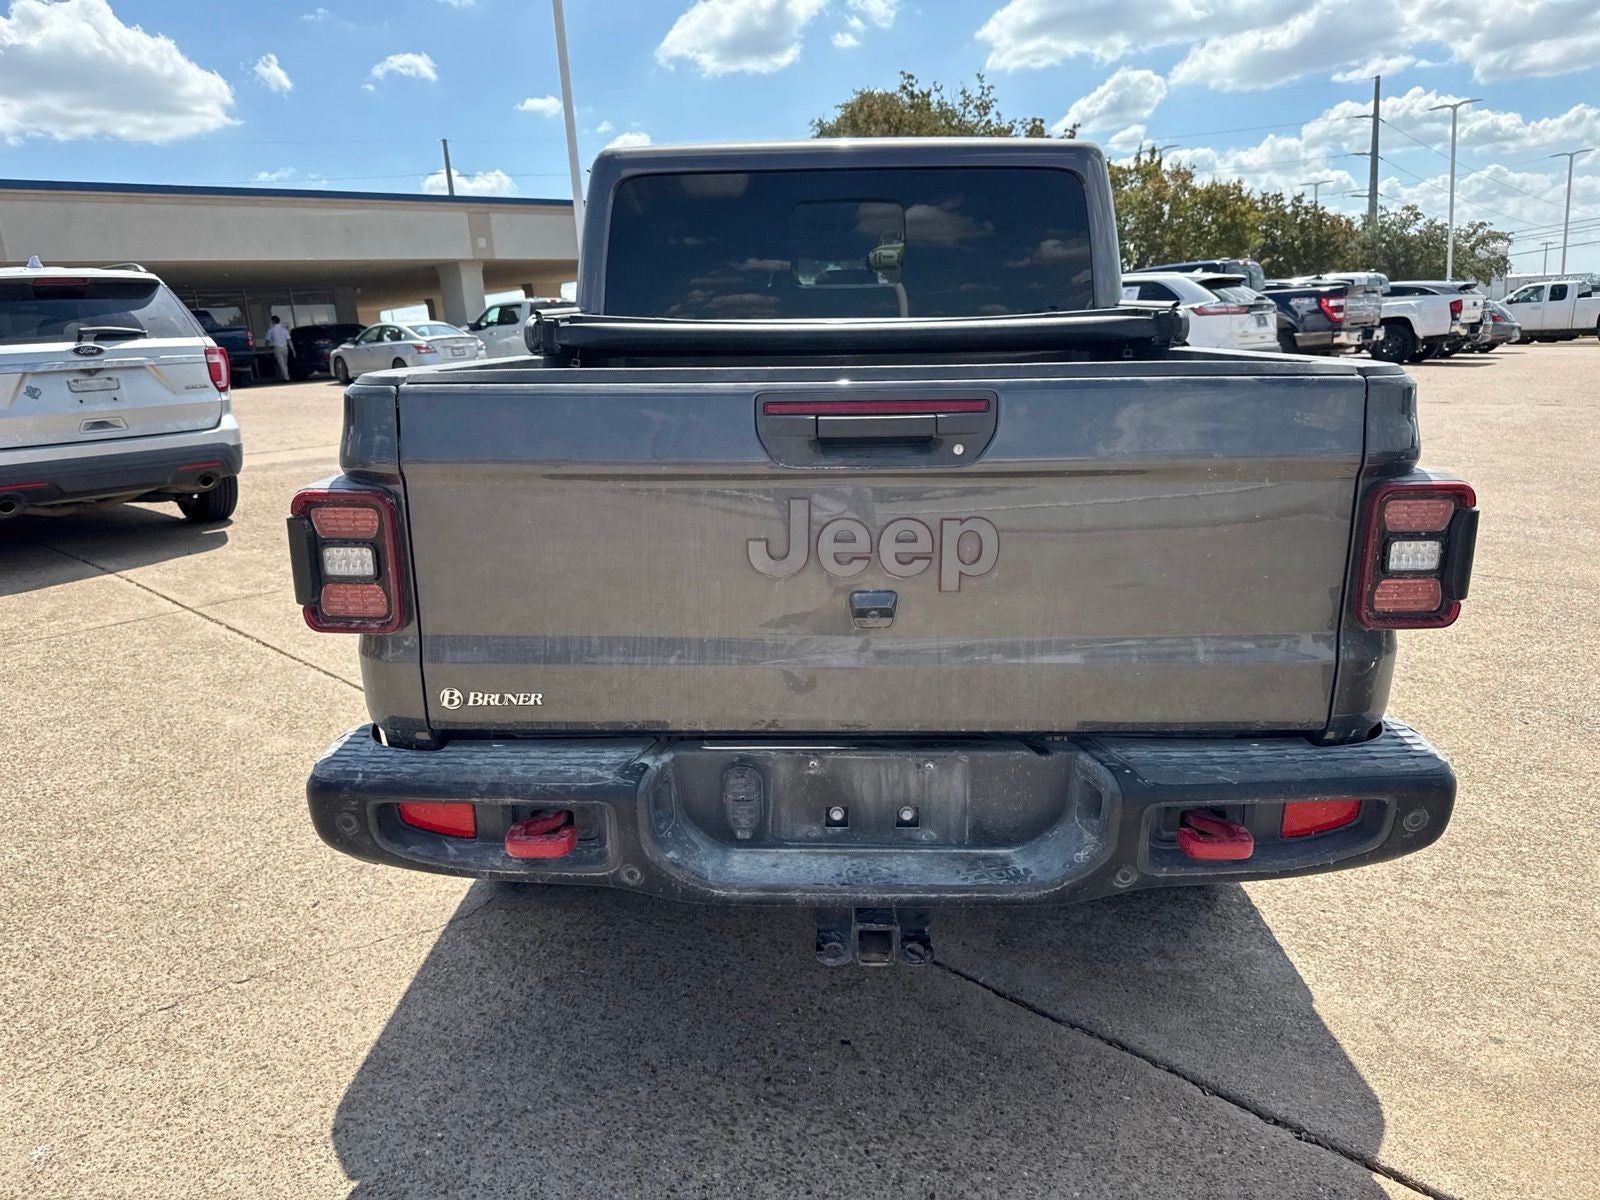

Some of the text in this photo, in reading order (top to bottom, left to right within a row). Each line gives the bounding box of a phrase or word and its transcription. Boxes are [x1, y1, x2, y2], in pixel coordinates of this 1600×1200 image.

[79, 346, 98, 355] Ford
[747, 498, 1000, 592] Jeep
[467, 691, 544, 707] BRUNER
